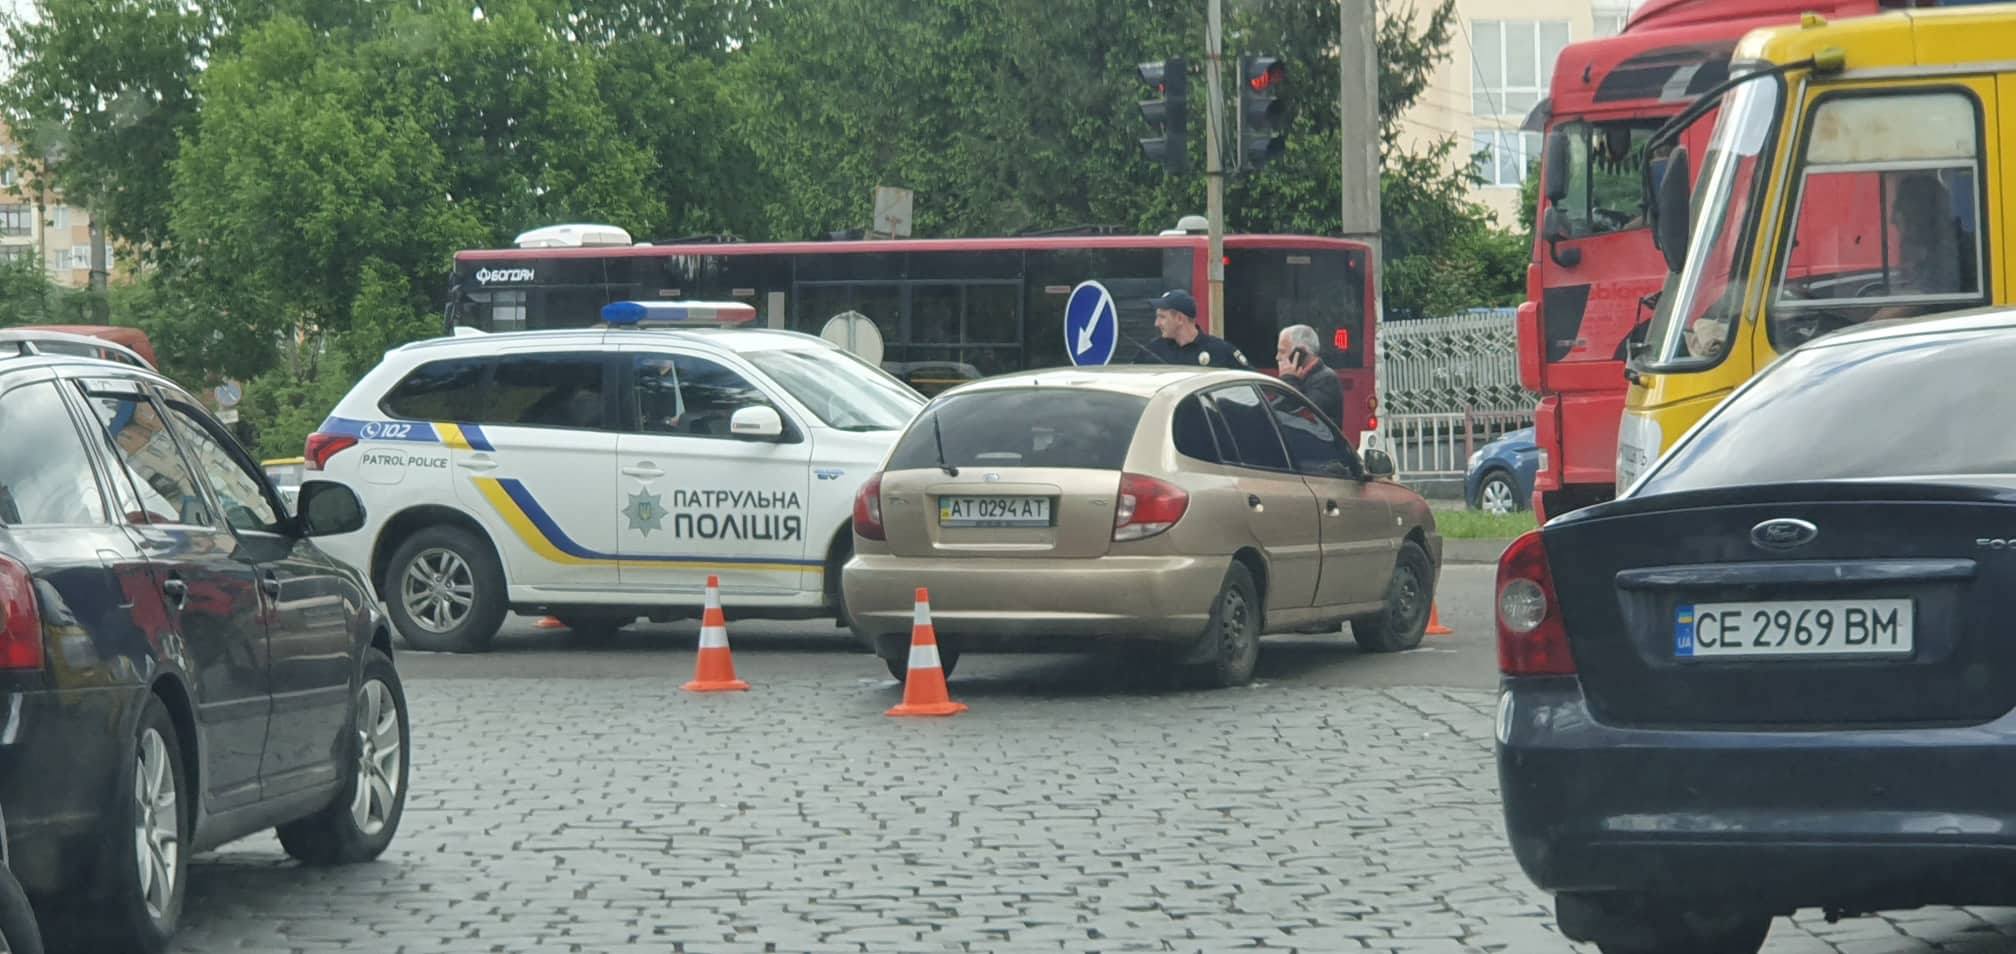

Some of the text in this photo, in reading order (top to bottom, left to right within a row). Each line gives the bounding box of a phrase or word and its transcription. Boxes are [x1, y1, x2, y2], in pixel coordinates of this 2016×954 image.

[490, 268, 535, 282] БОГДАН
[381, 423, 411, 438] 102
[362, 454, 448, 469] PATROL POLICE
[673, 489, 801, 509] ПАТРУЛЬНА
[951, 500, 1045, 517] AT 0294 AT
[675, 513, 802, 541] ПОЛІЦІЯ
[1695, 607, 1899, 648] CE 2969 BM
[1677, 636, 1692, 648] UA
